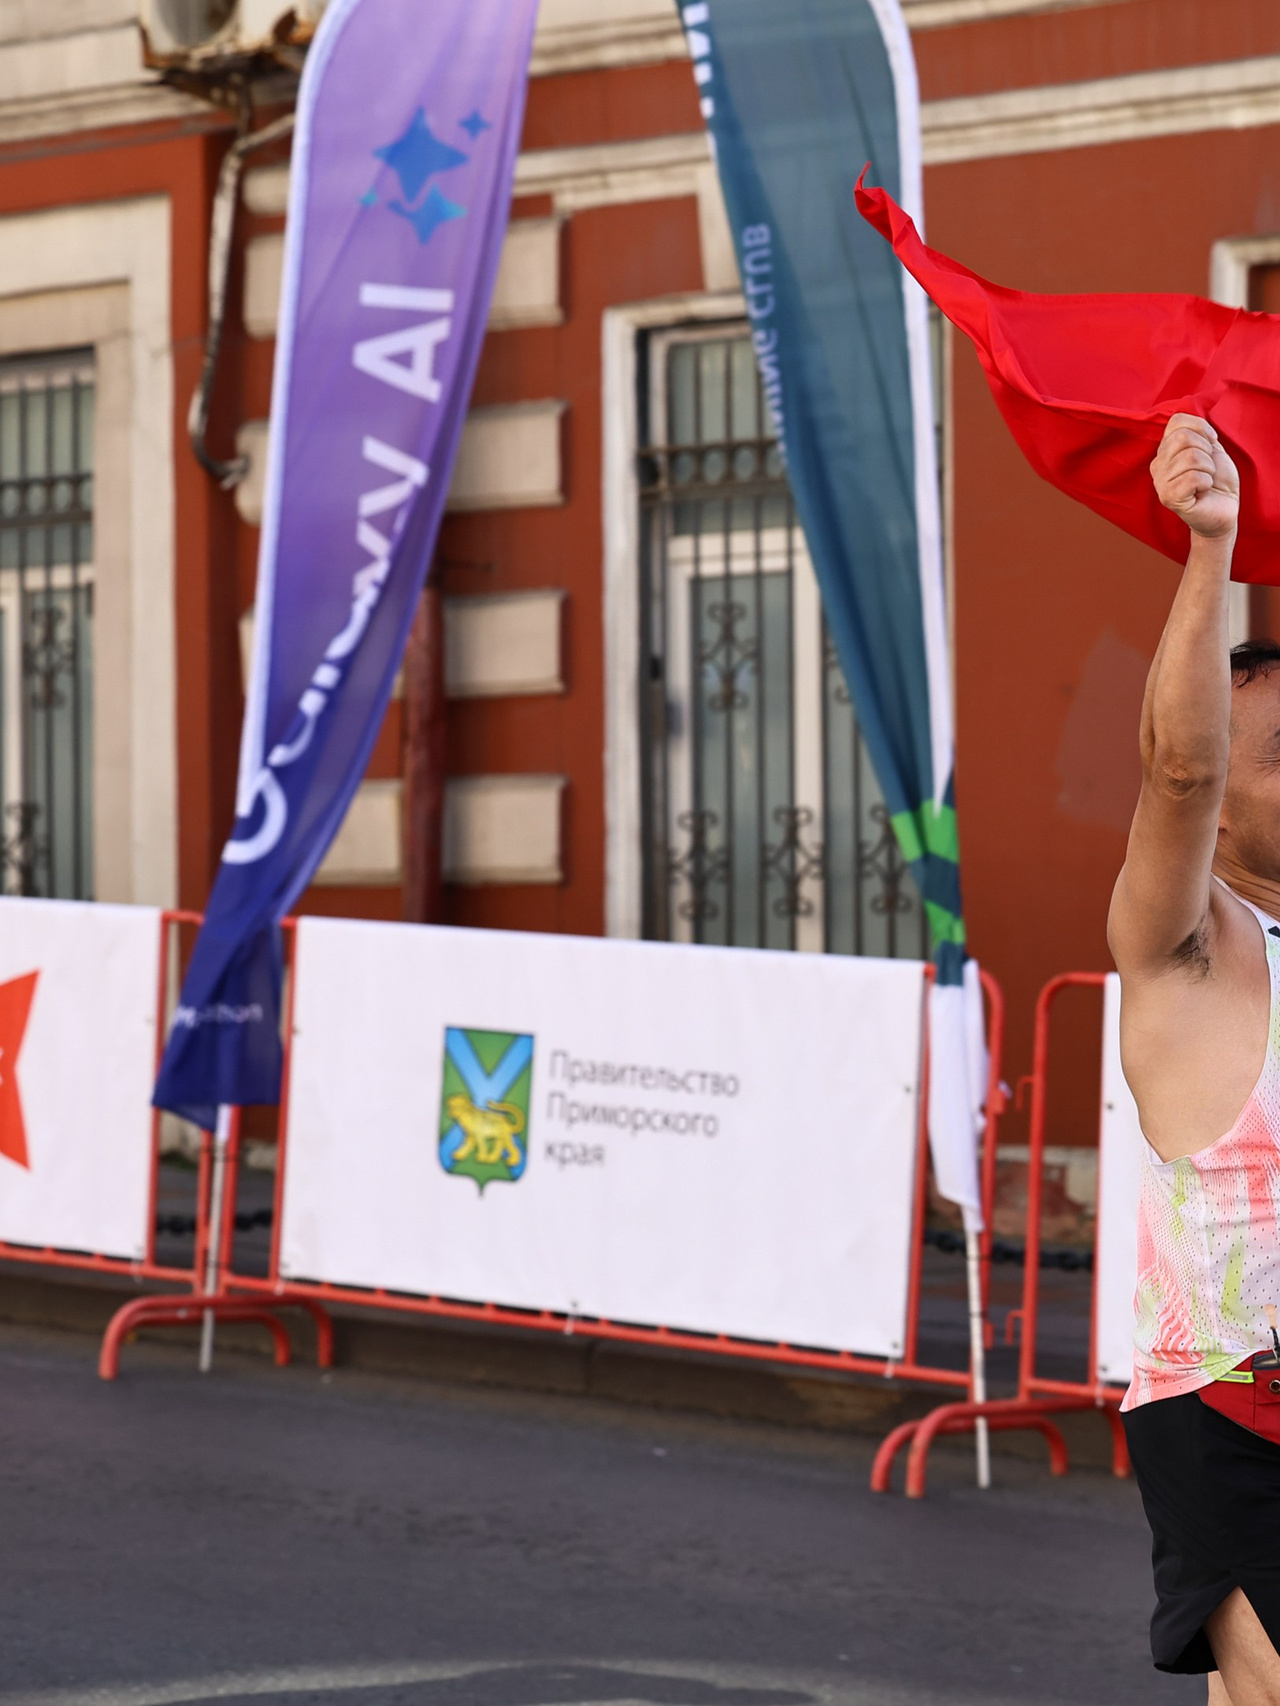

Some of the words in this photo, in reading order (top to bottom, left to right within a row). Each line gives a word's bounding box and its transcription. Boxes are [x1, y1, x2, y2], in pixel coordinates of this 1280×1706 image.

[352, 283, 456, 402] AI
[549, 1049, 740, 1098] Правительство
[547, 1091, 720, 1138] Приморского
[545, 1142, 605, 1170] края
